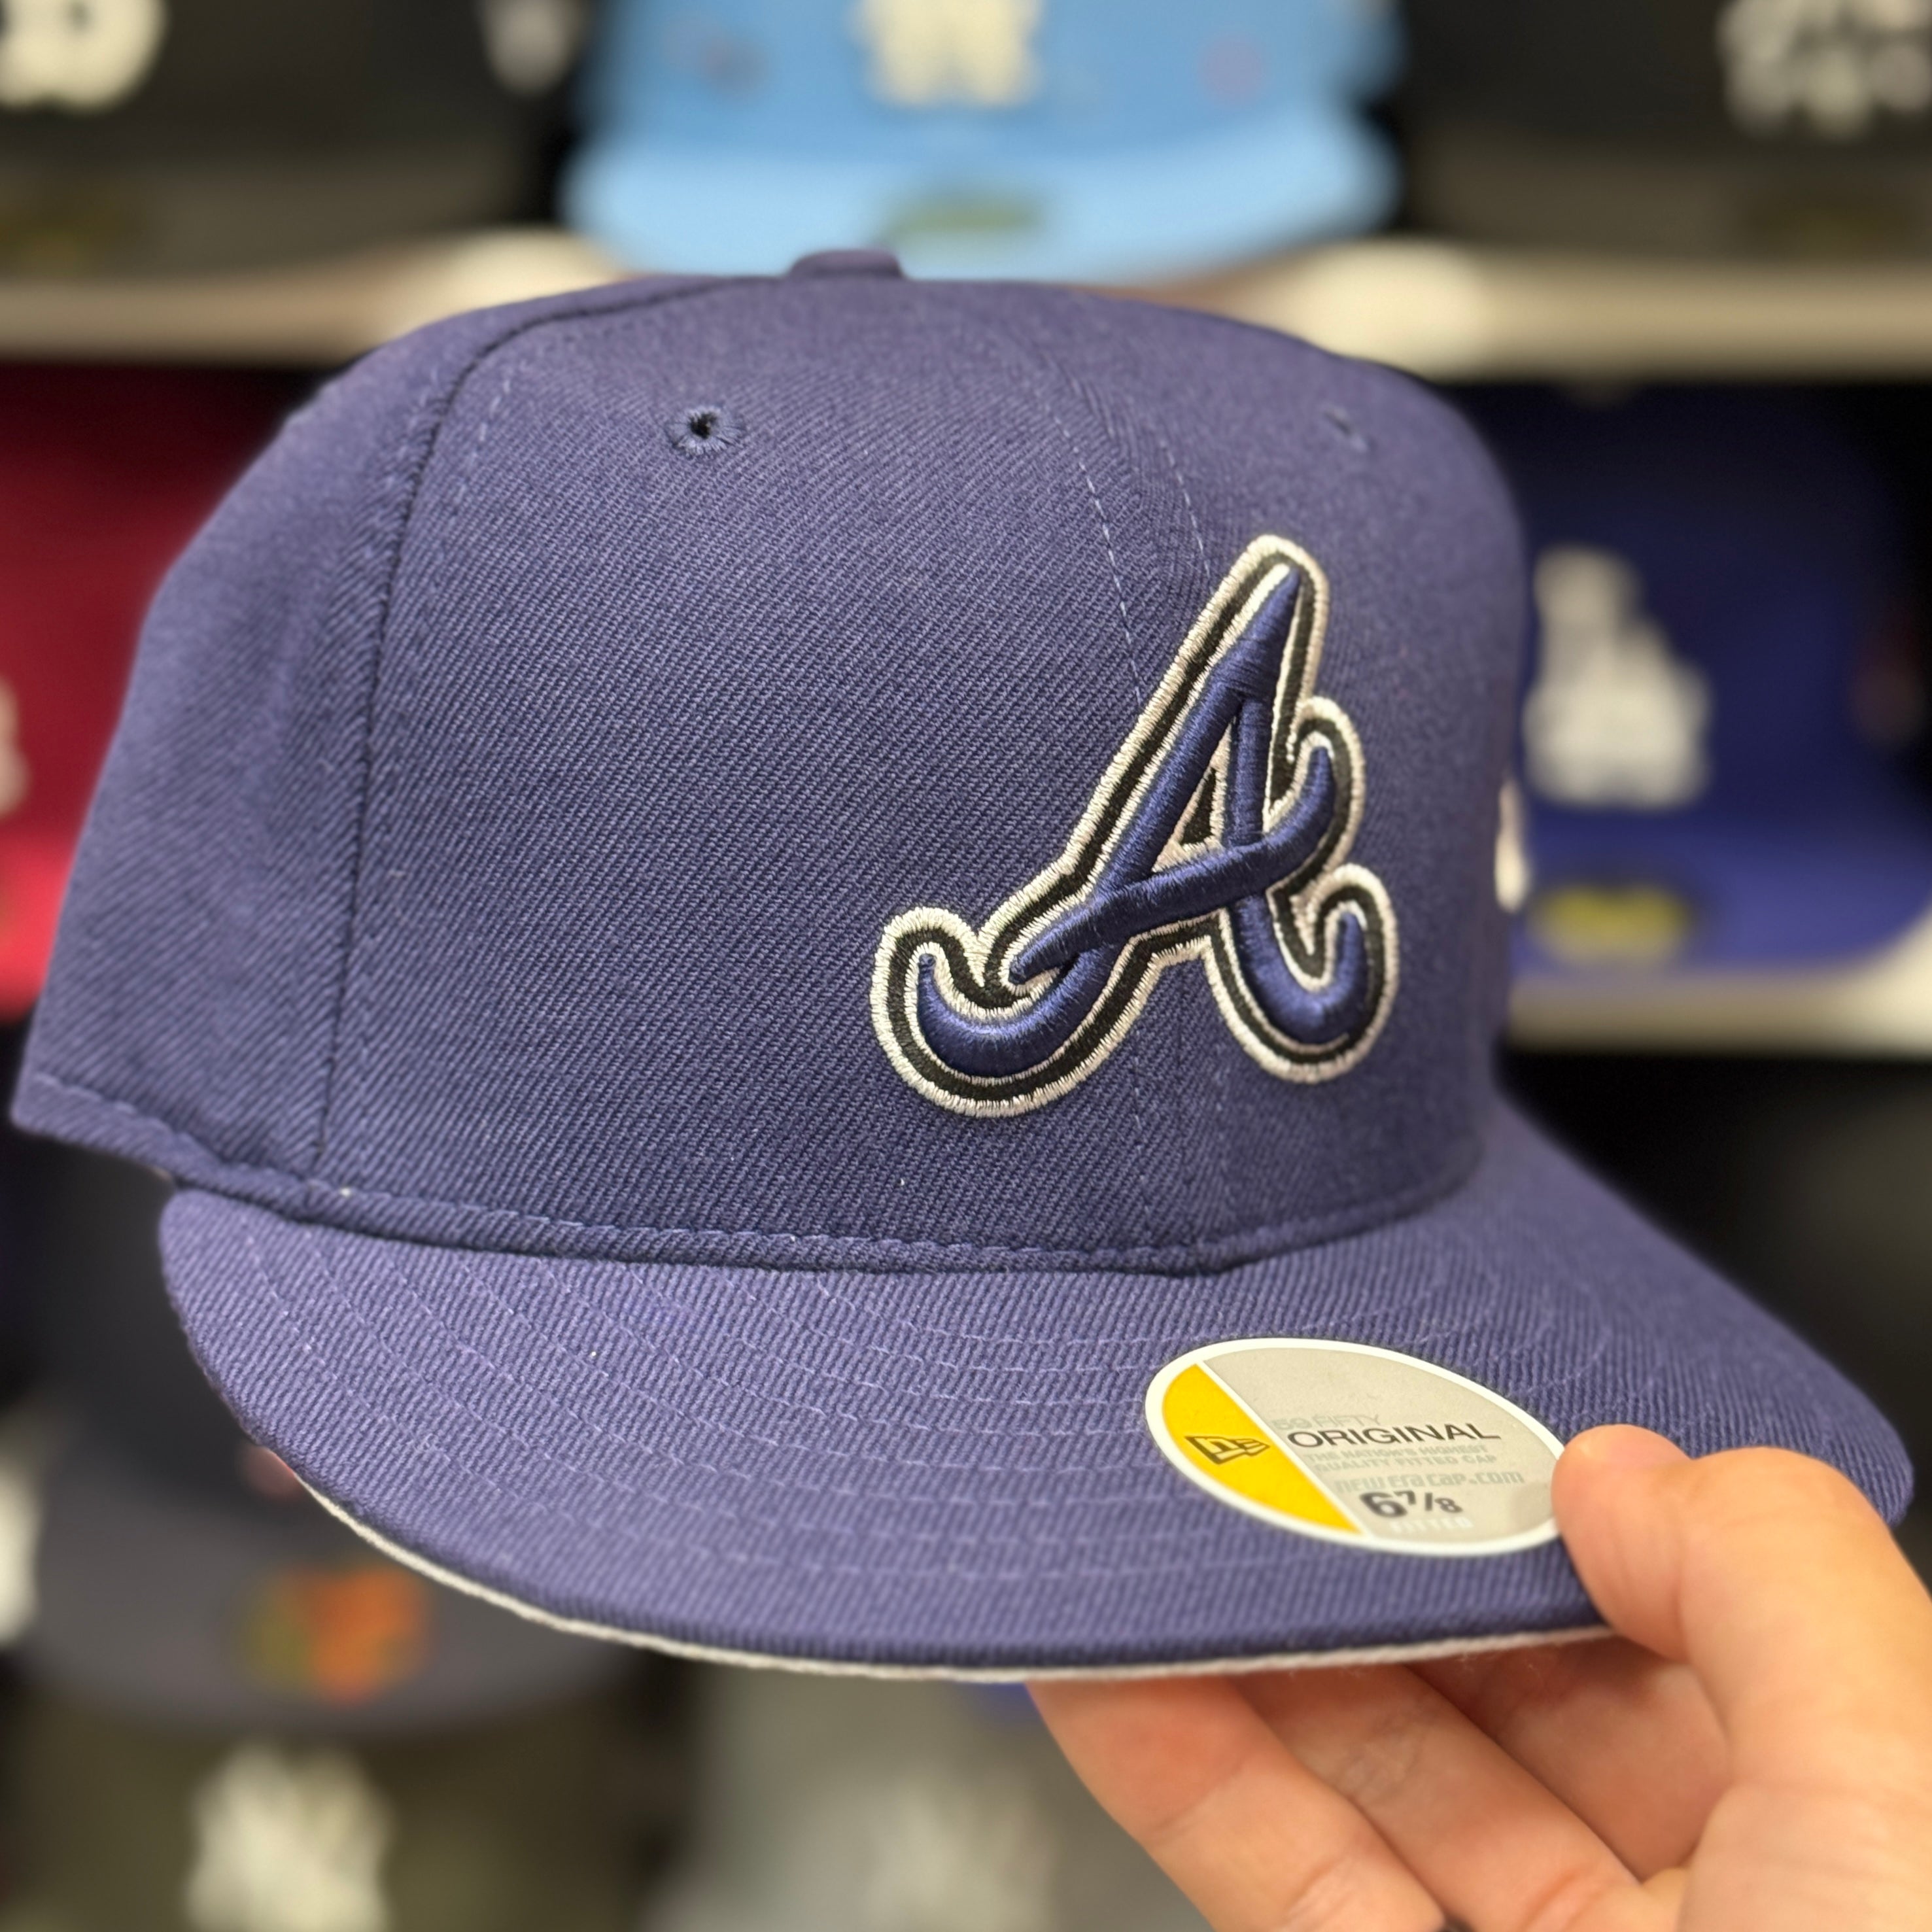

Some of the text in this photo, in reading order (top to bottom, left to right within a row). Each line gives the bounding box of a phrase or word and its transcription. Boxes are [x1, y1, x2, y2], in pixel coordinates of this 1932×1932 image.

[872, 534, 1399, 1119] A
[1287, 1422, 1502, 1448] ORIGINAL
[1460, 1454, 1497, 1464] CAP
